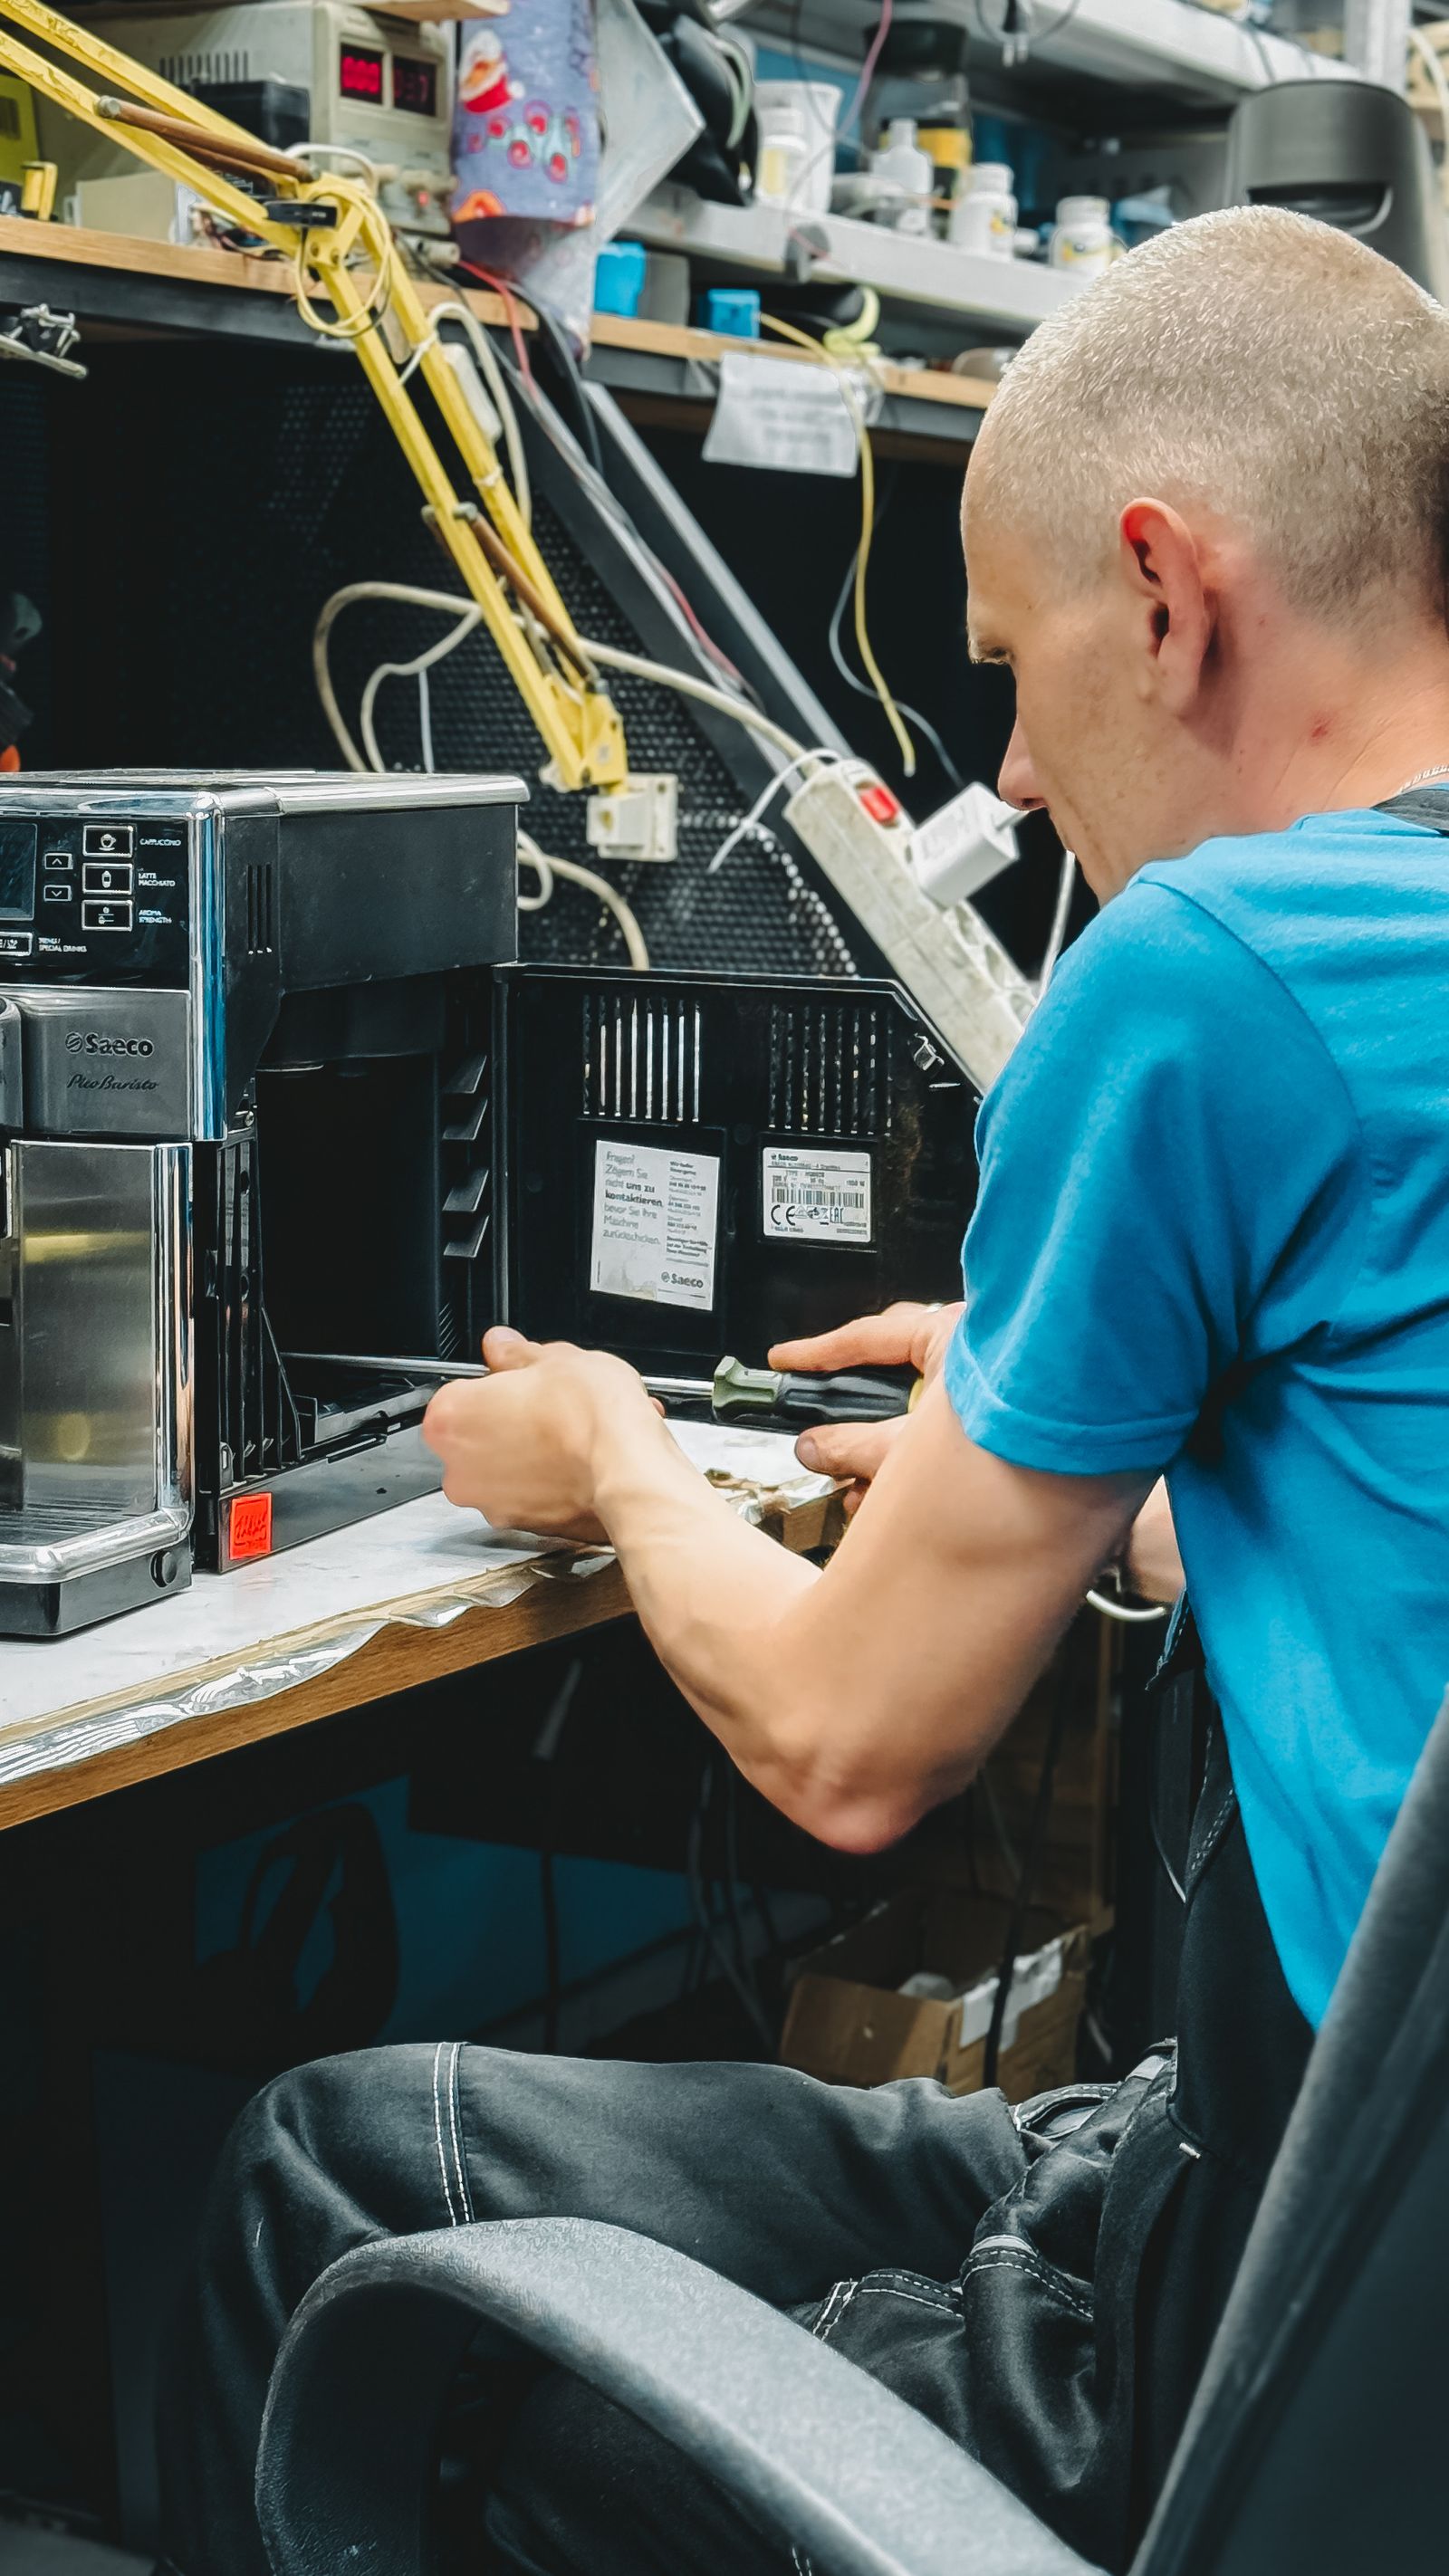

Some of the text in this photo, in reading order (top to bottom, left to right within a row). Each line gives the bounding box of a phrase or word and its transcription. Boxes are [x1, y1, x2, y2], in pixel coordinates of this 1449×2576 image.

[85, 1032, 154, 1058] Saeco
[626, 1183, 642, 1192] uns
[644, 1185, 655, 1193] zu
[670, 1273, 704, 1288] Saeco
